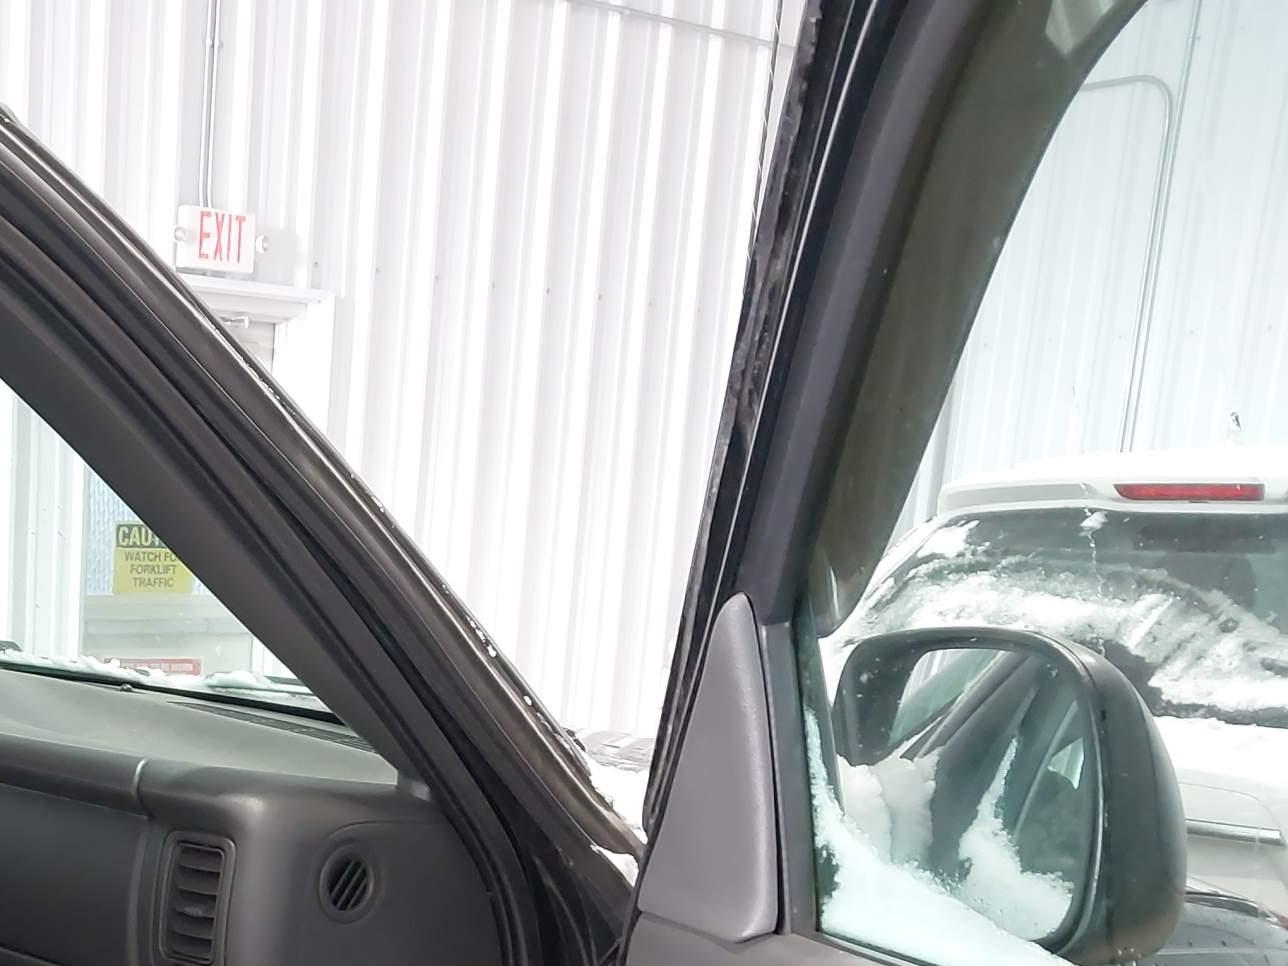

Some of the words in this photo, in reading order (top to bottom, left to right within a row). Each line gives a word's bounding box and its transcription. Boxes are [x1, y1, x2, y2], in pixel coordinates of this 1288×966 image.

[199, 210, 246, 264] EXIT
[124, 551, 161, 561] WATCH
[164, 551, 176, 561] FO
[130, 564, 177, 574] FORKLIFT
[132, 577, 174, 587] TRAFFIC
